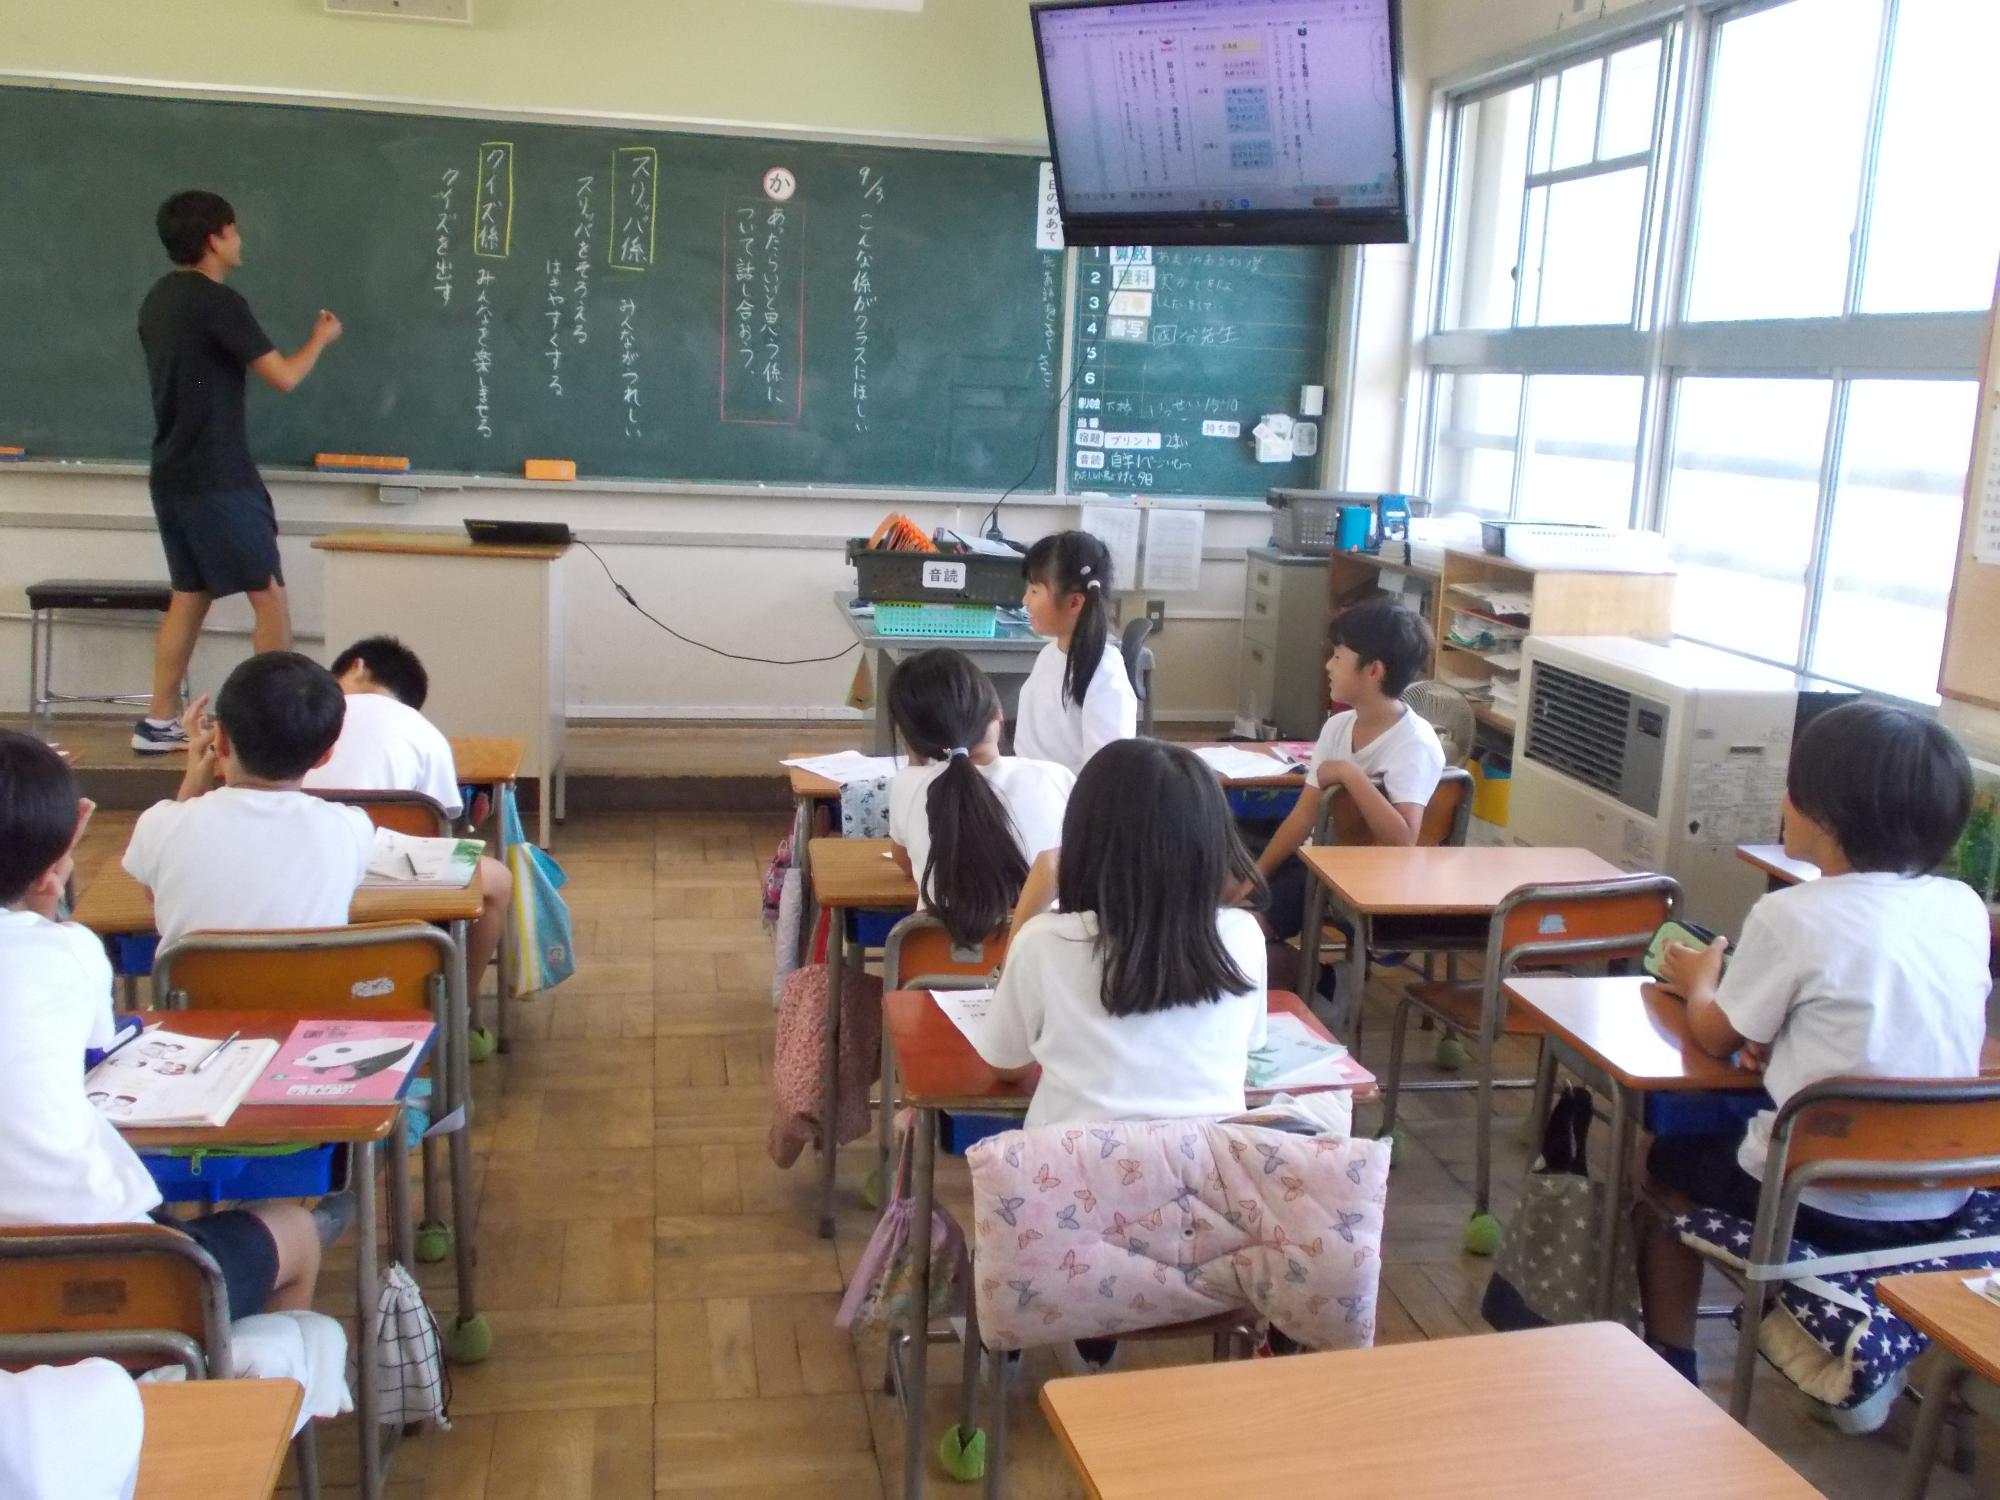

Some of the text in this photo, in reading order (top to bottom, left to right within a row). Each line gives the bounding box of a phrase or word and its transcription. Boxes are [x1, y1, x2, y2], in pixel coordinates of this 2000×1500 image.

[769, 172, 791, 194] か
[479, 149, 504, 249] クイズ係
[1046, 167, 1060, 241] 日のめあて
[621, 156, 651, 263] スリッパ係
[433, 168, 459, 304] クイズを出す
[1090, 272, 1101, 284] 2
[1089, 297, 1100, 308] 3
[852, 213, 878, 432] こんな係がクラスにほしい
[1087, 322, 1098, 334] 4
[1110, 319, 1144, 337] 書写
[1086, 347, 1097, 359] 5
[1085, 372, 1095, 384] 6
[1111, 436, 1153, 447] プリント
[928, 568, 958, 582] 音読
